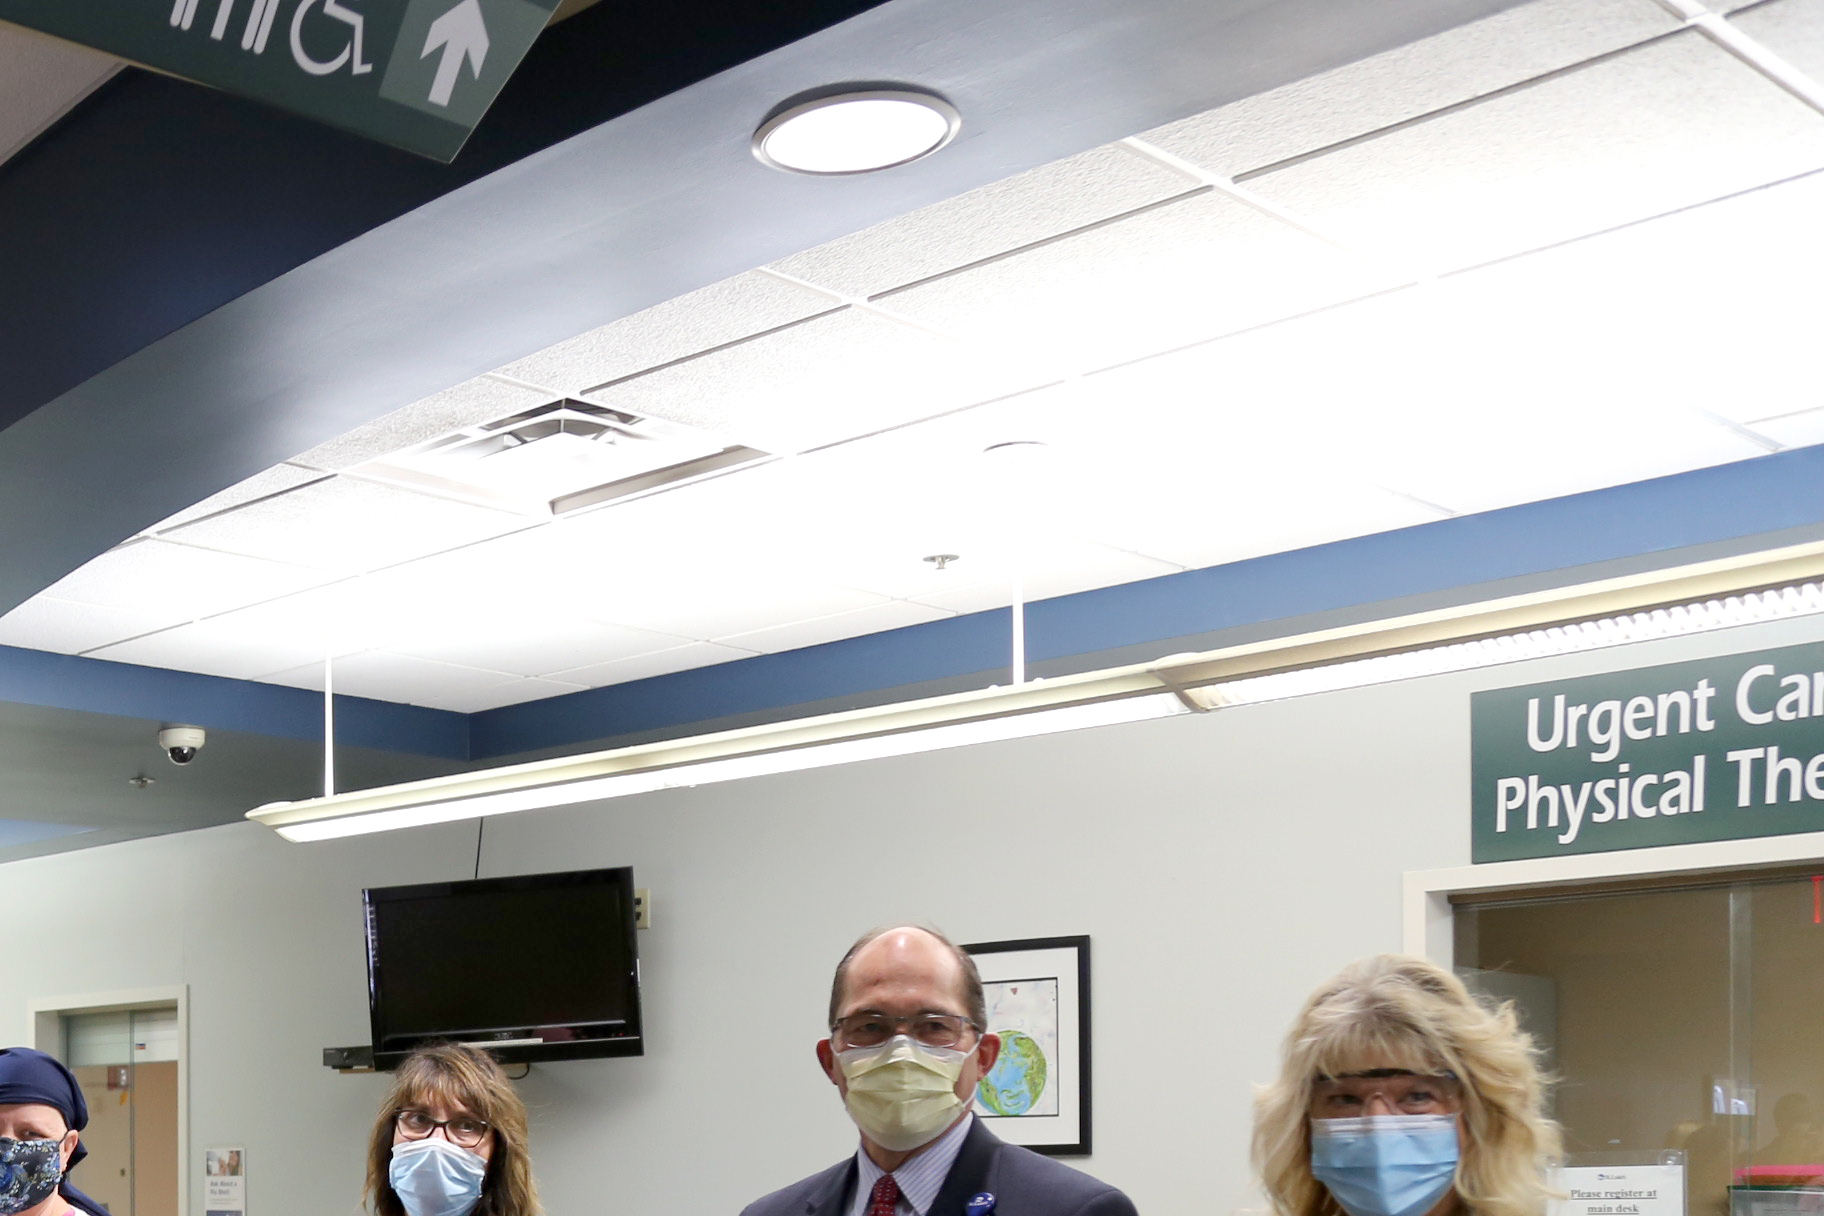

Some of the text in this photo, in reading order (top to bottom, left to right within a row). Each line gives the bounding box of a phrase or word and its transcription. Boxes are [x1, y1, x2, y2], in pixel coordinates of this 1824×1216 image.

[1527, 678, 1716, 763] Urgent
[1495, 754, 1706, 845] Physical
[1570, 1189, 1658, 1200] Please register at
[1587, 1204, 1640, 1213] main desk
